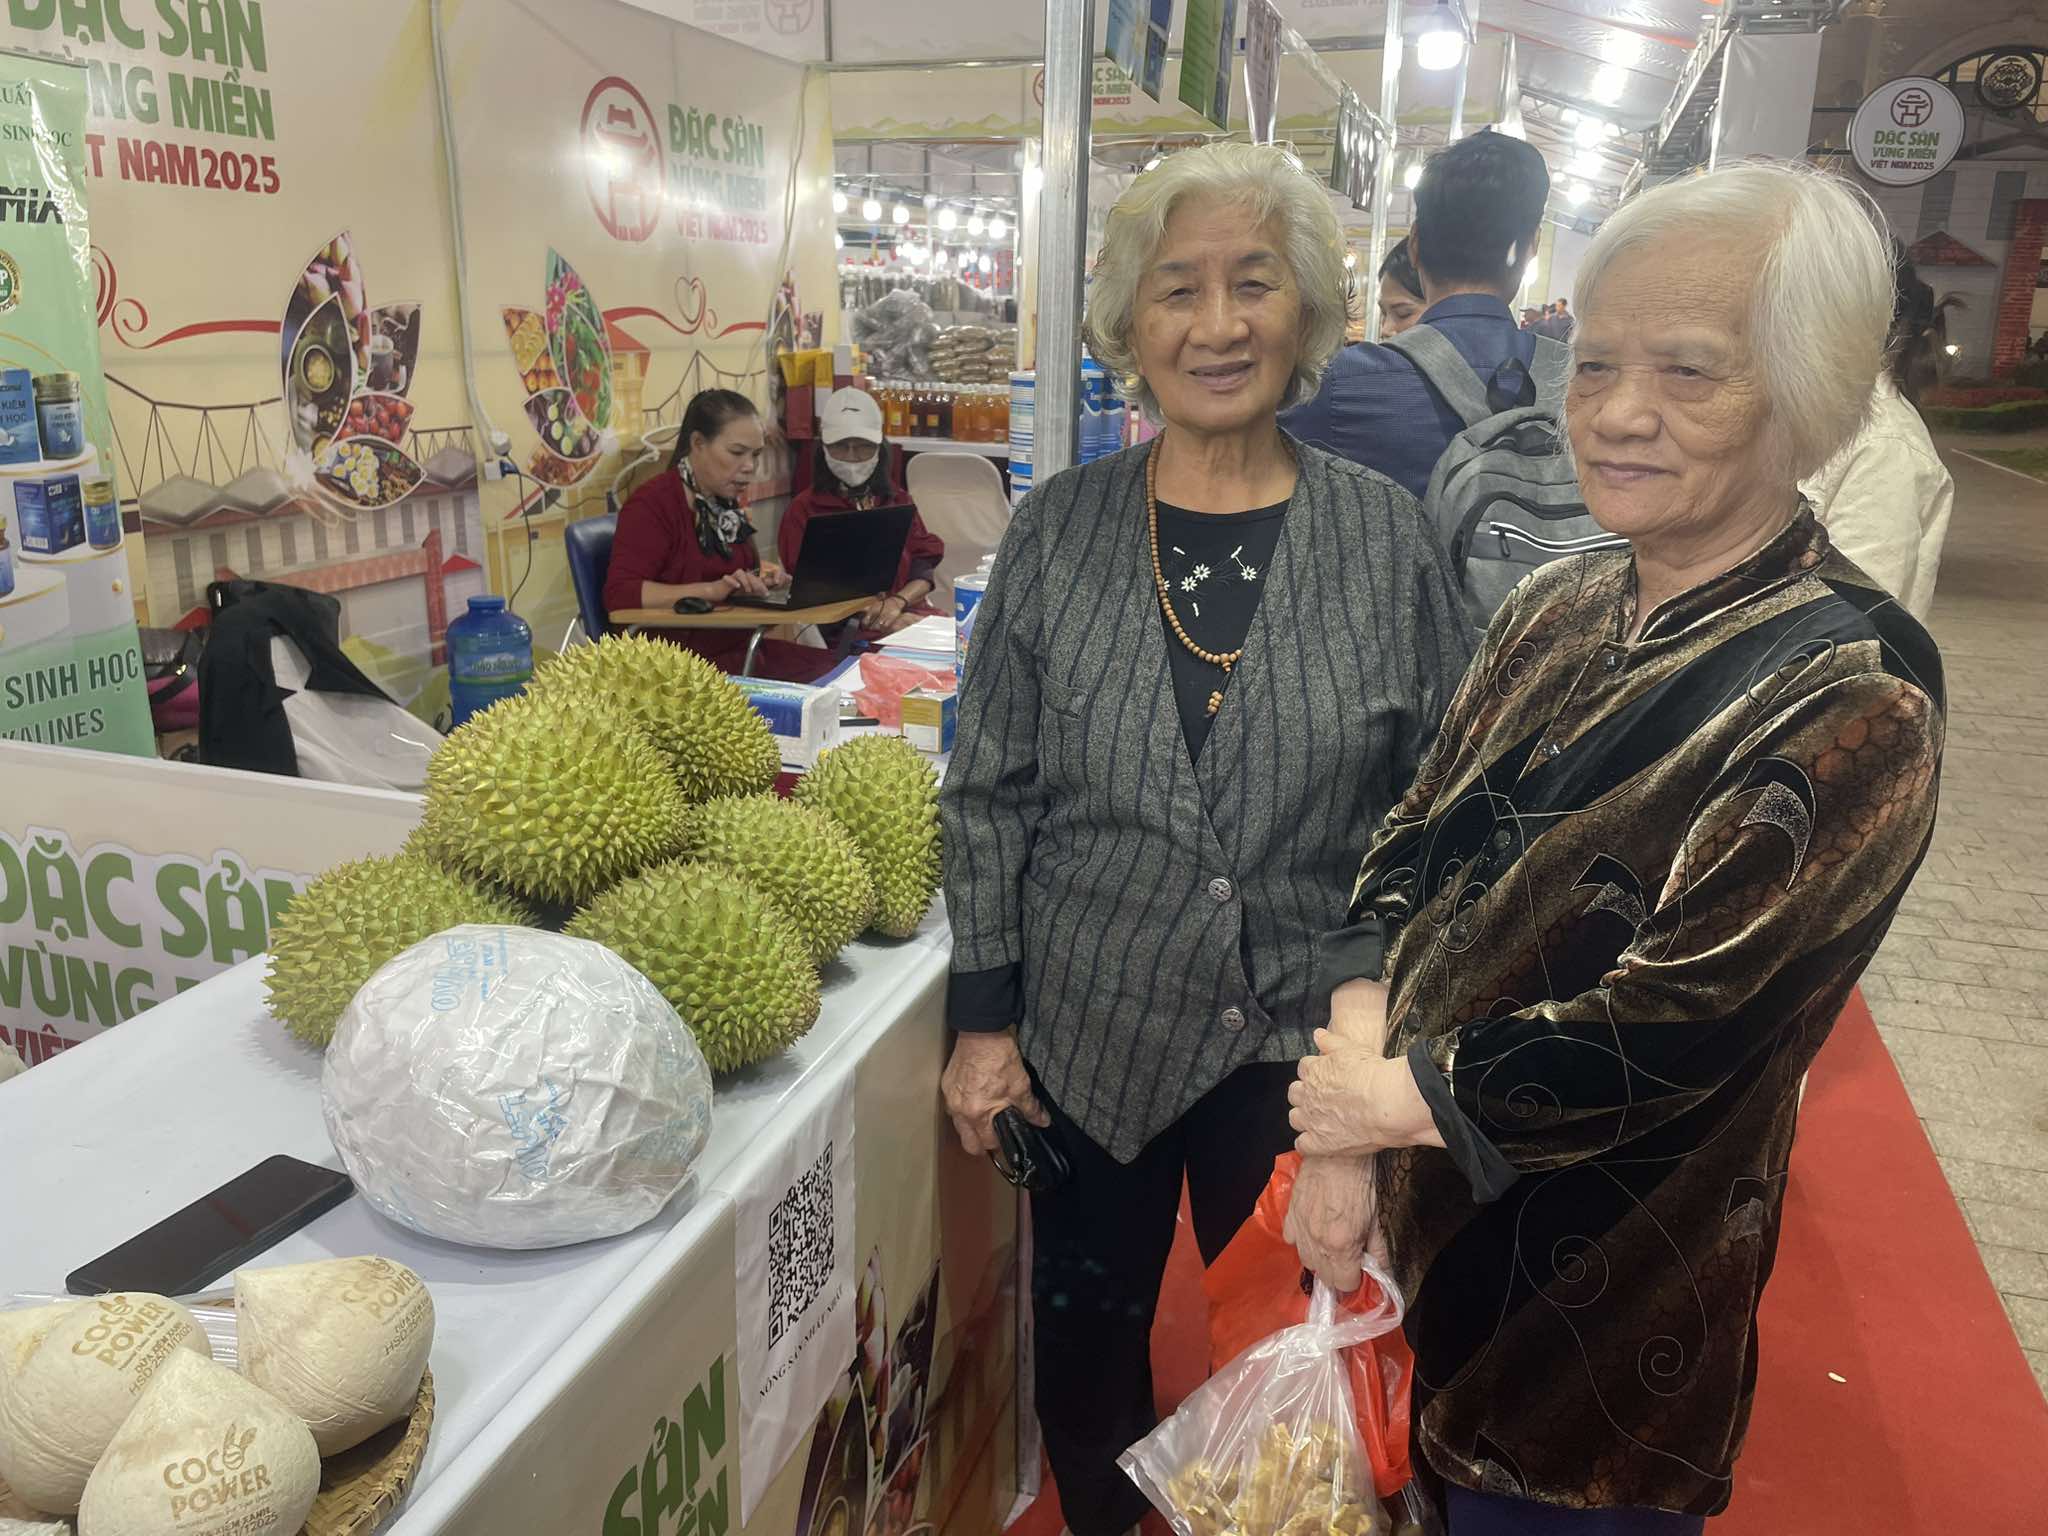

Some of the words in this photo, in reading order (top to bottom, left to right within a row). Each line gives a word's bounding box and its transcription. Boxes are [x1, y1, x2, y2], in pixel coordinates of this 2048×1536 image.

[168, 68, 275, 141] MIỀN
[668, 103, 719, 161] ĐẶC
[722, 115, 765, 168] SẢN
[5, 662, 79, 709] SINH
[88, 649, 139, 692] HỌC
[96, 1301, 168, 1367] POWER
[170, 1464, 272, 1521] POWER
